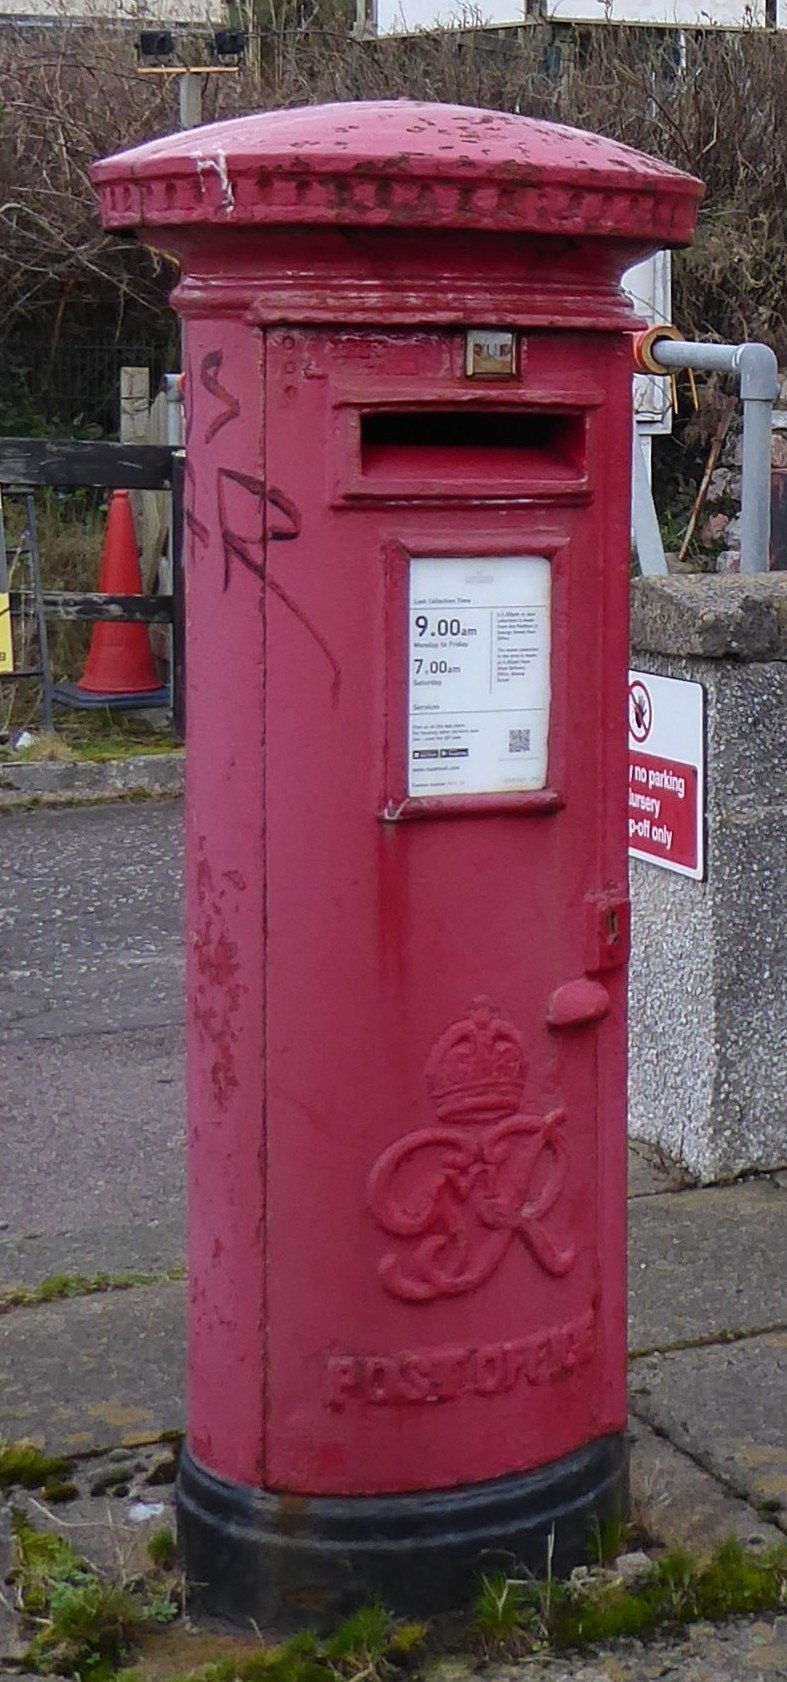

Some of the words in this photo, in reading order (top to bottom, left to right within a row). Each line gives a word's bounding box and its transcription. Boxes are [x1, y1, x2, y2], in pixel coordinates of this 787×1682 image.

[415, 615, 477, 637] 9.00am
[448, 640, 469, 648] Friday
[413, 658, 461, 675] 7.00am
[413, 679, 442, 687] Saturday
[634, 765, 647, 783] no
[648, 769, 685, 799] parking
[652, 825, 672, 850] only
[326, 1350, 467, 1404] POST
